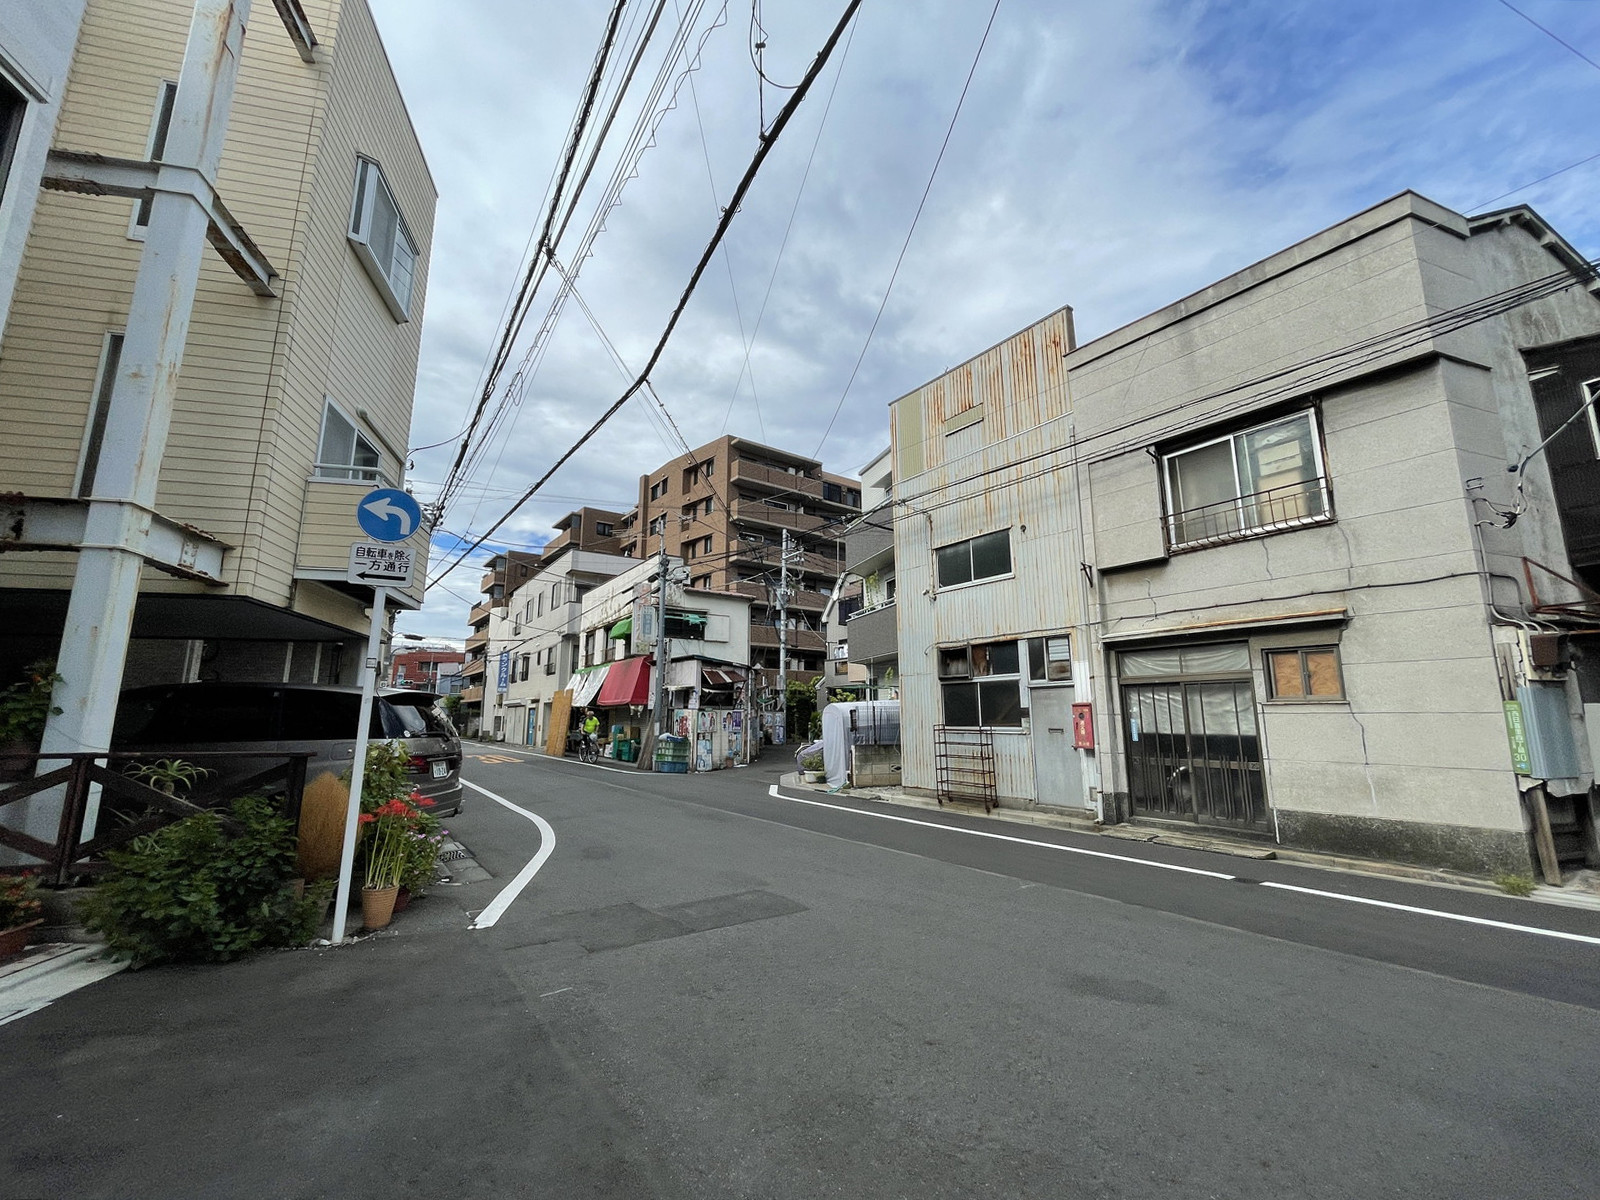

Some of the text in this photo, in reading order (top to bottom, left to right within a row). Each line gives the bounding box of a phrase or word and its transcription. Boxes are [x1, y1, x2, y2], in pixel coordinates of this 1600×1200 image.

[356, 546, 411, 562] 自転車を除く
[354, 560, 410, 573] 一方通行
[1514, 753, 1527, 762] 30
